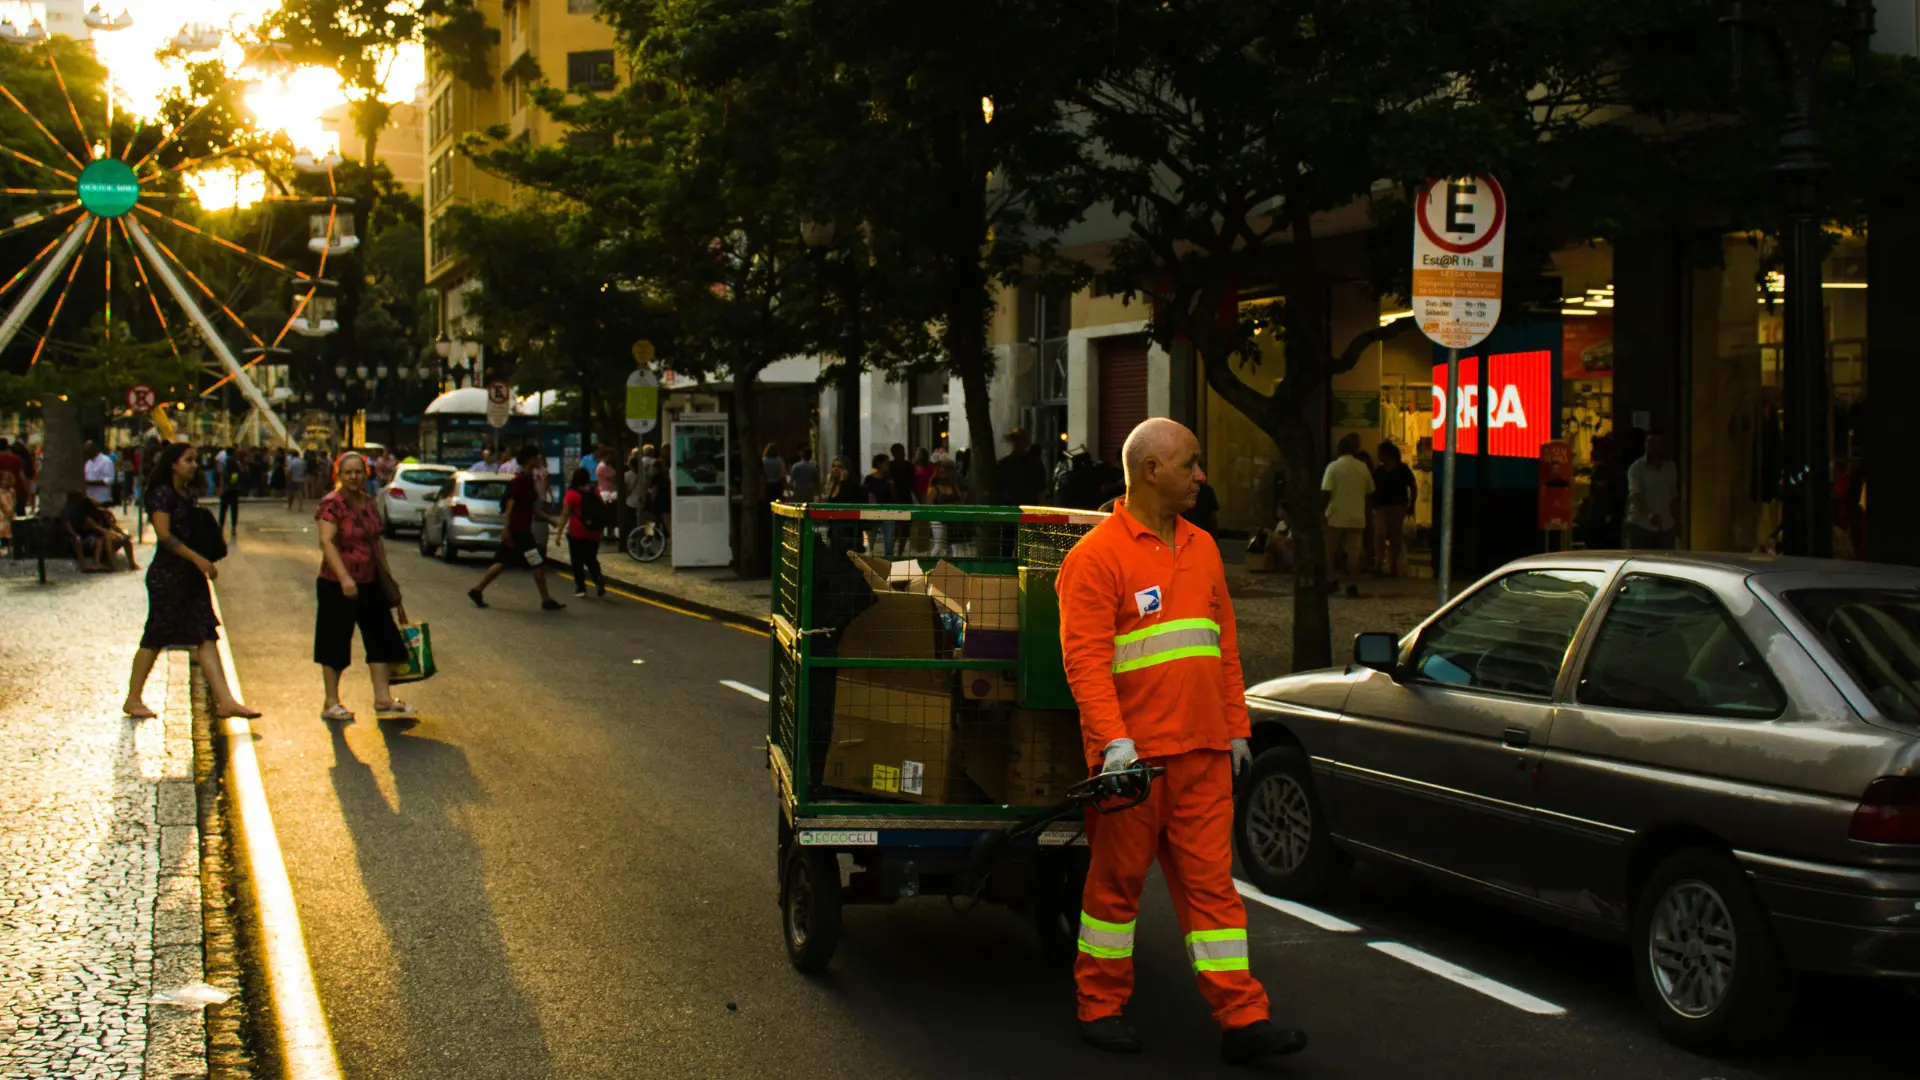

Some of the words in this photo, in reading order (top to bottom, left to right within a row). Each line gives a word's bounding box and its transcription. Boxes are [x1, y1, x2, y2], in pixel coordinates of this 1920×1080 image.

[1446, 183, 1477, 233] E
[1422, 254, 1459, 267] Est@R
[815, 833, 876, 843] ECCOCELL
